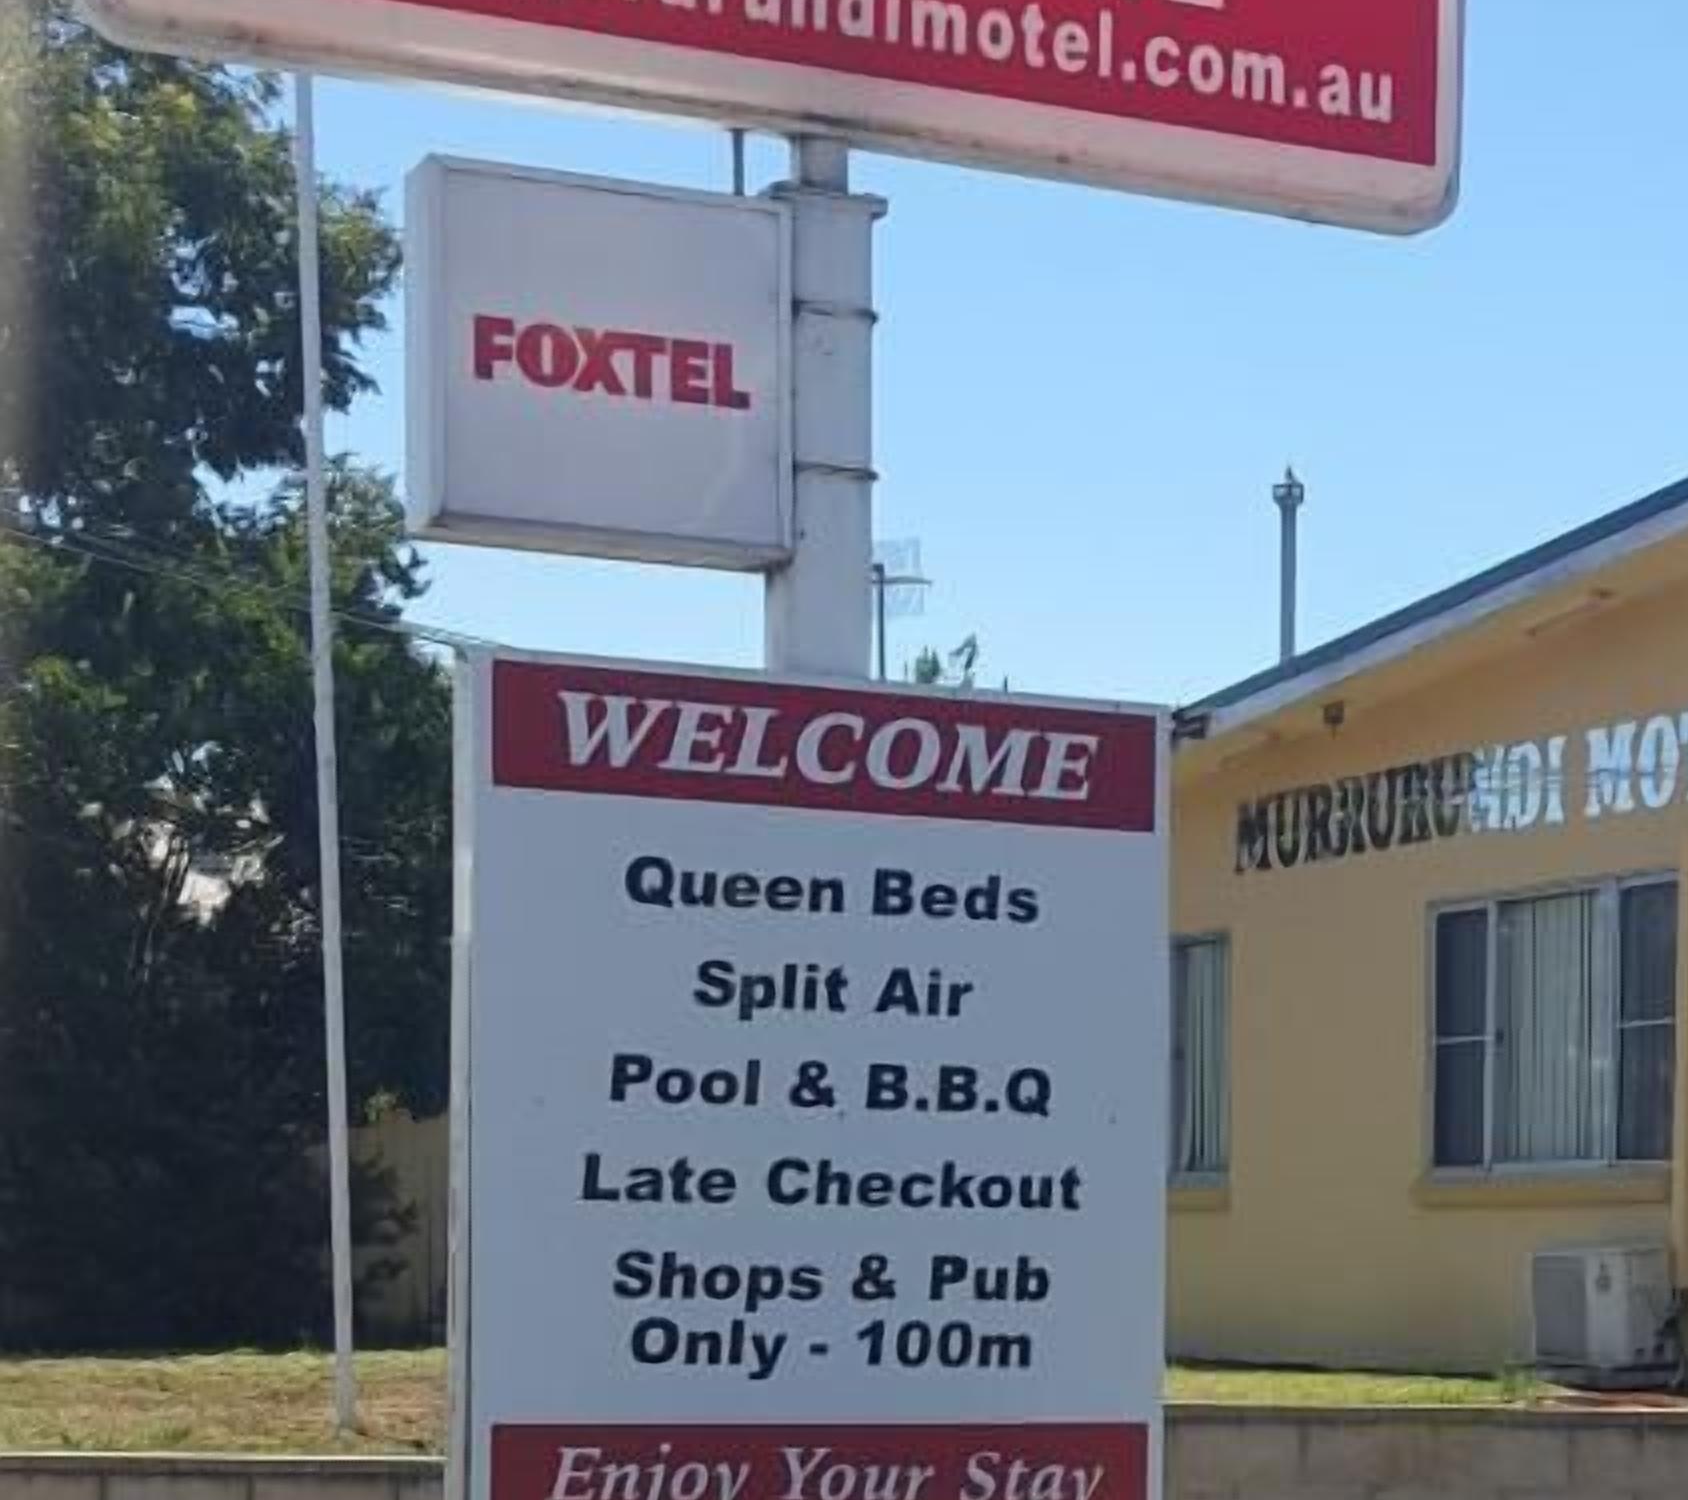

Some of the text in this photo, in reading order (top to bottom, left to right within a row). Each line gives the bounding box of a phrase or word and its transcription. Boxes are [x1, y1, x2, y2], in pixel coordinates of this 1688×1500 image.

[472, 314, 751, 412] FOXTEL
[559, 689, 1099, 804] WELCOME
[1234, 736, 1565, 875] MURRURUNDI
[625, 855, 1041, 926] Queen Beds
[693, 958, 974, 1023] Split Air
[609, 1054, 1051, 1118] Pool & B.B.Q
[581, 1154, 1082, 1211] Late Checkout
[612, 1251, 1050, 1314] Shops & Pub
[630, 1317, 786, 1379] Only
[857, 1322, 1032, 1370] 100m
